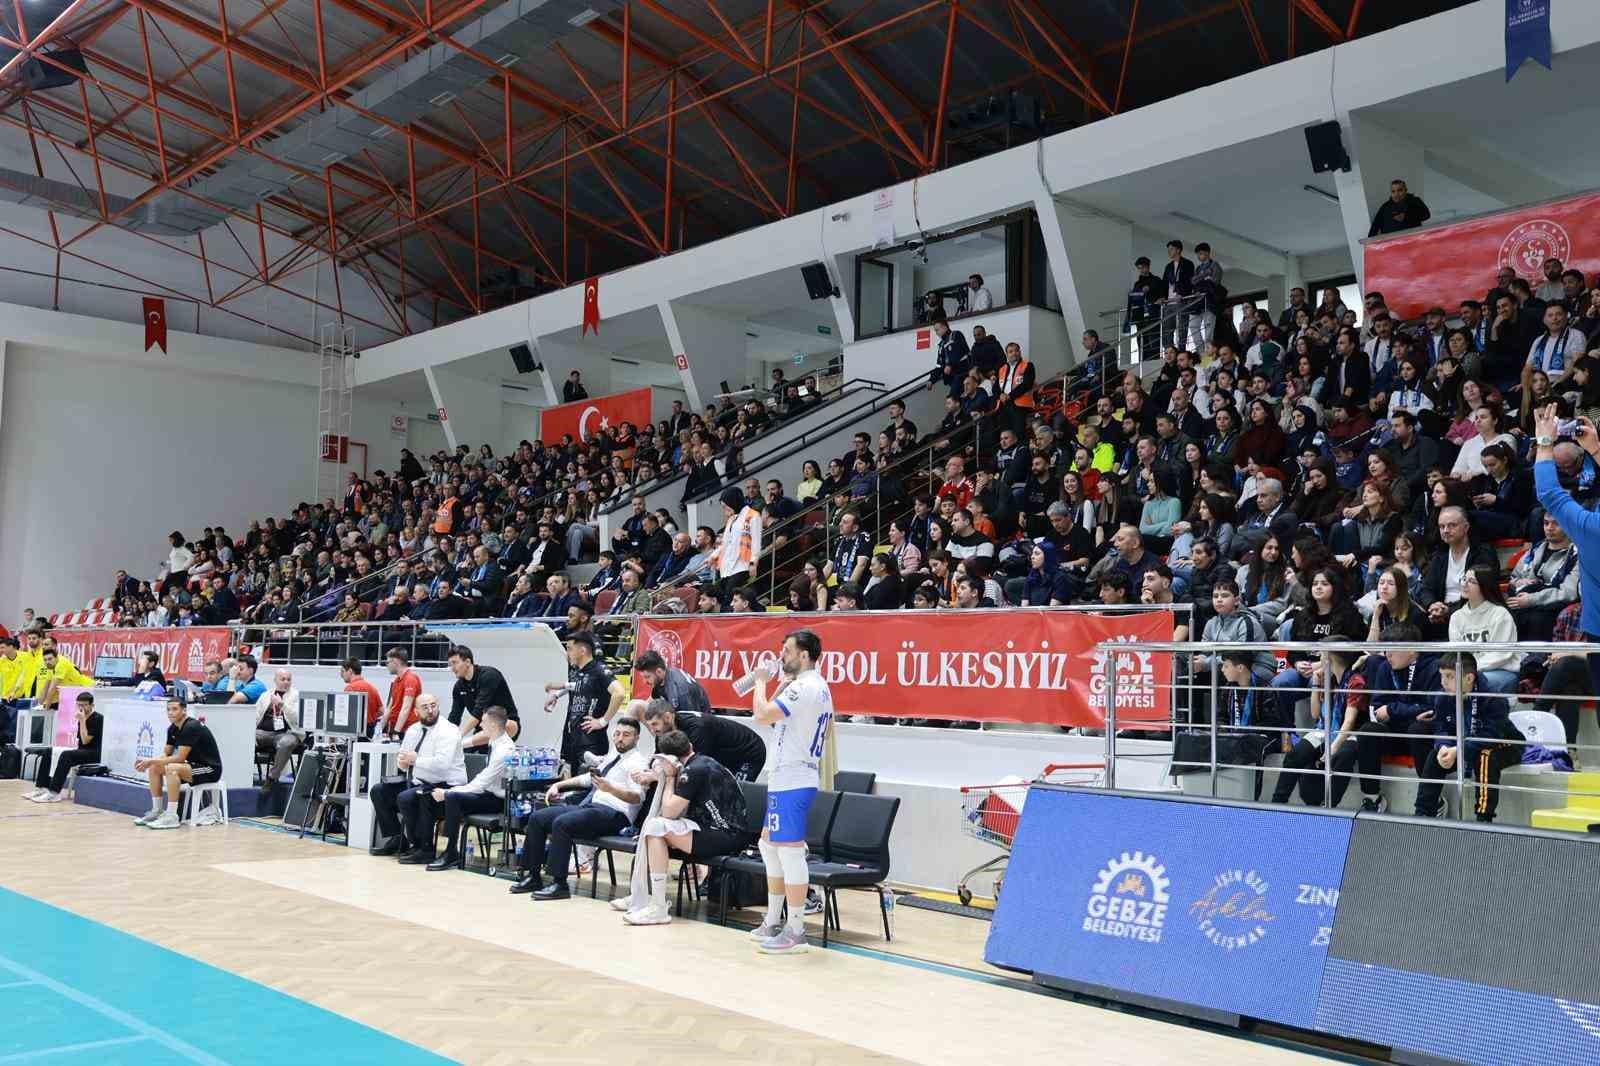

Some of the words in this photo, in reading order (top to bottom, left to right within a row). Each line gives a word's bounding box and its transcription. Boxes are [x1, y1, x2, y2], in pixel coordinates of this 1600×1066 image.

[695, 641, 733, 681] BİZ
[738, 649, 887, 686] VOBOL
[896, 641, 1069, 690] ÜLKESİYİZ
[1089, 674, 1155, 694] GBZE
[1088, 894, 1168, 928] GEBZE
